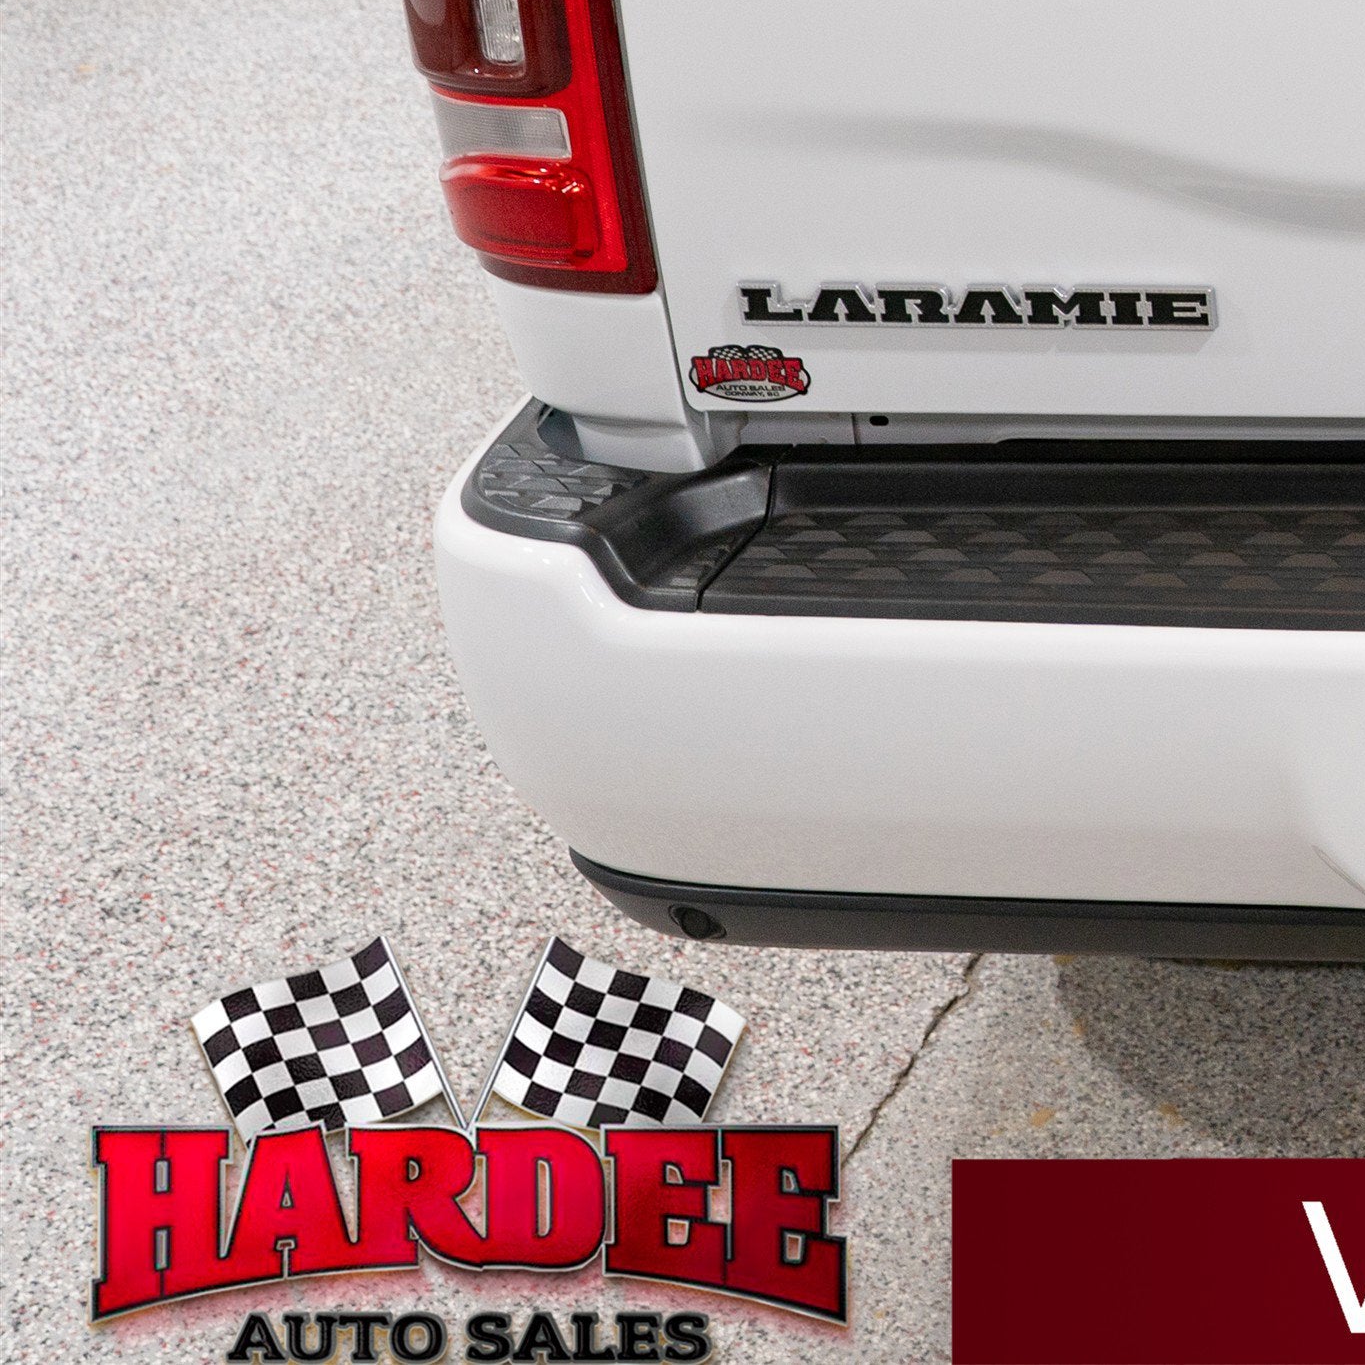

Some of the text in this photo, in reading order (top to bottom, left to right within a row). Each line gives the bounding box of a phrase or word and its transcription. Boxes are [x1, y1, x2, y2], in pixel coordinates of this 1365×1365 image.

[738, 282, 1218, 329] LARAMIE
[692, 356, 806, 394] HARDEE
[716, 384, 786, 392] AUTO SALES
